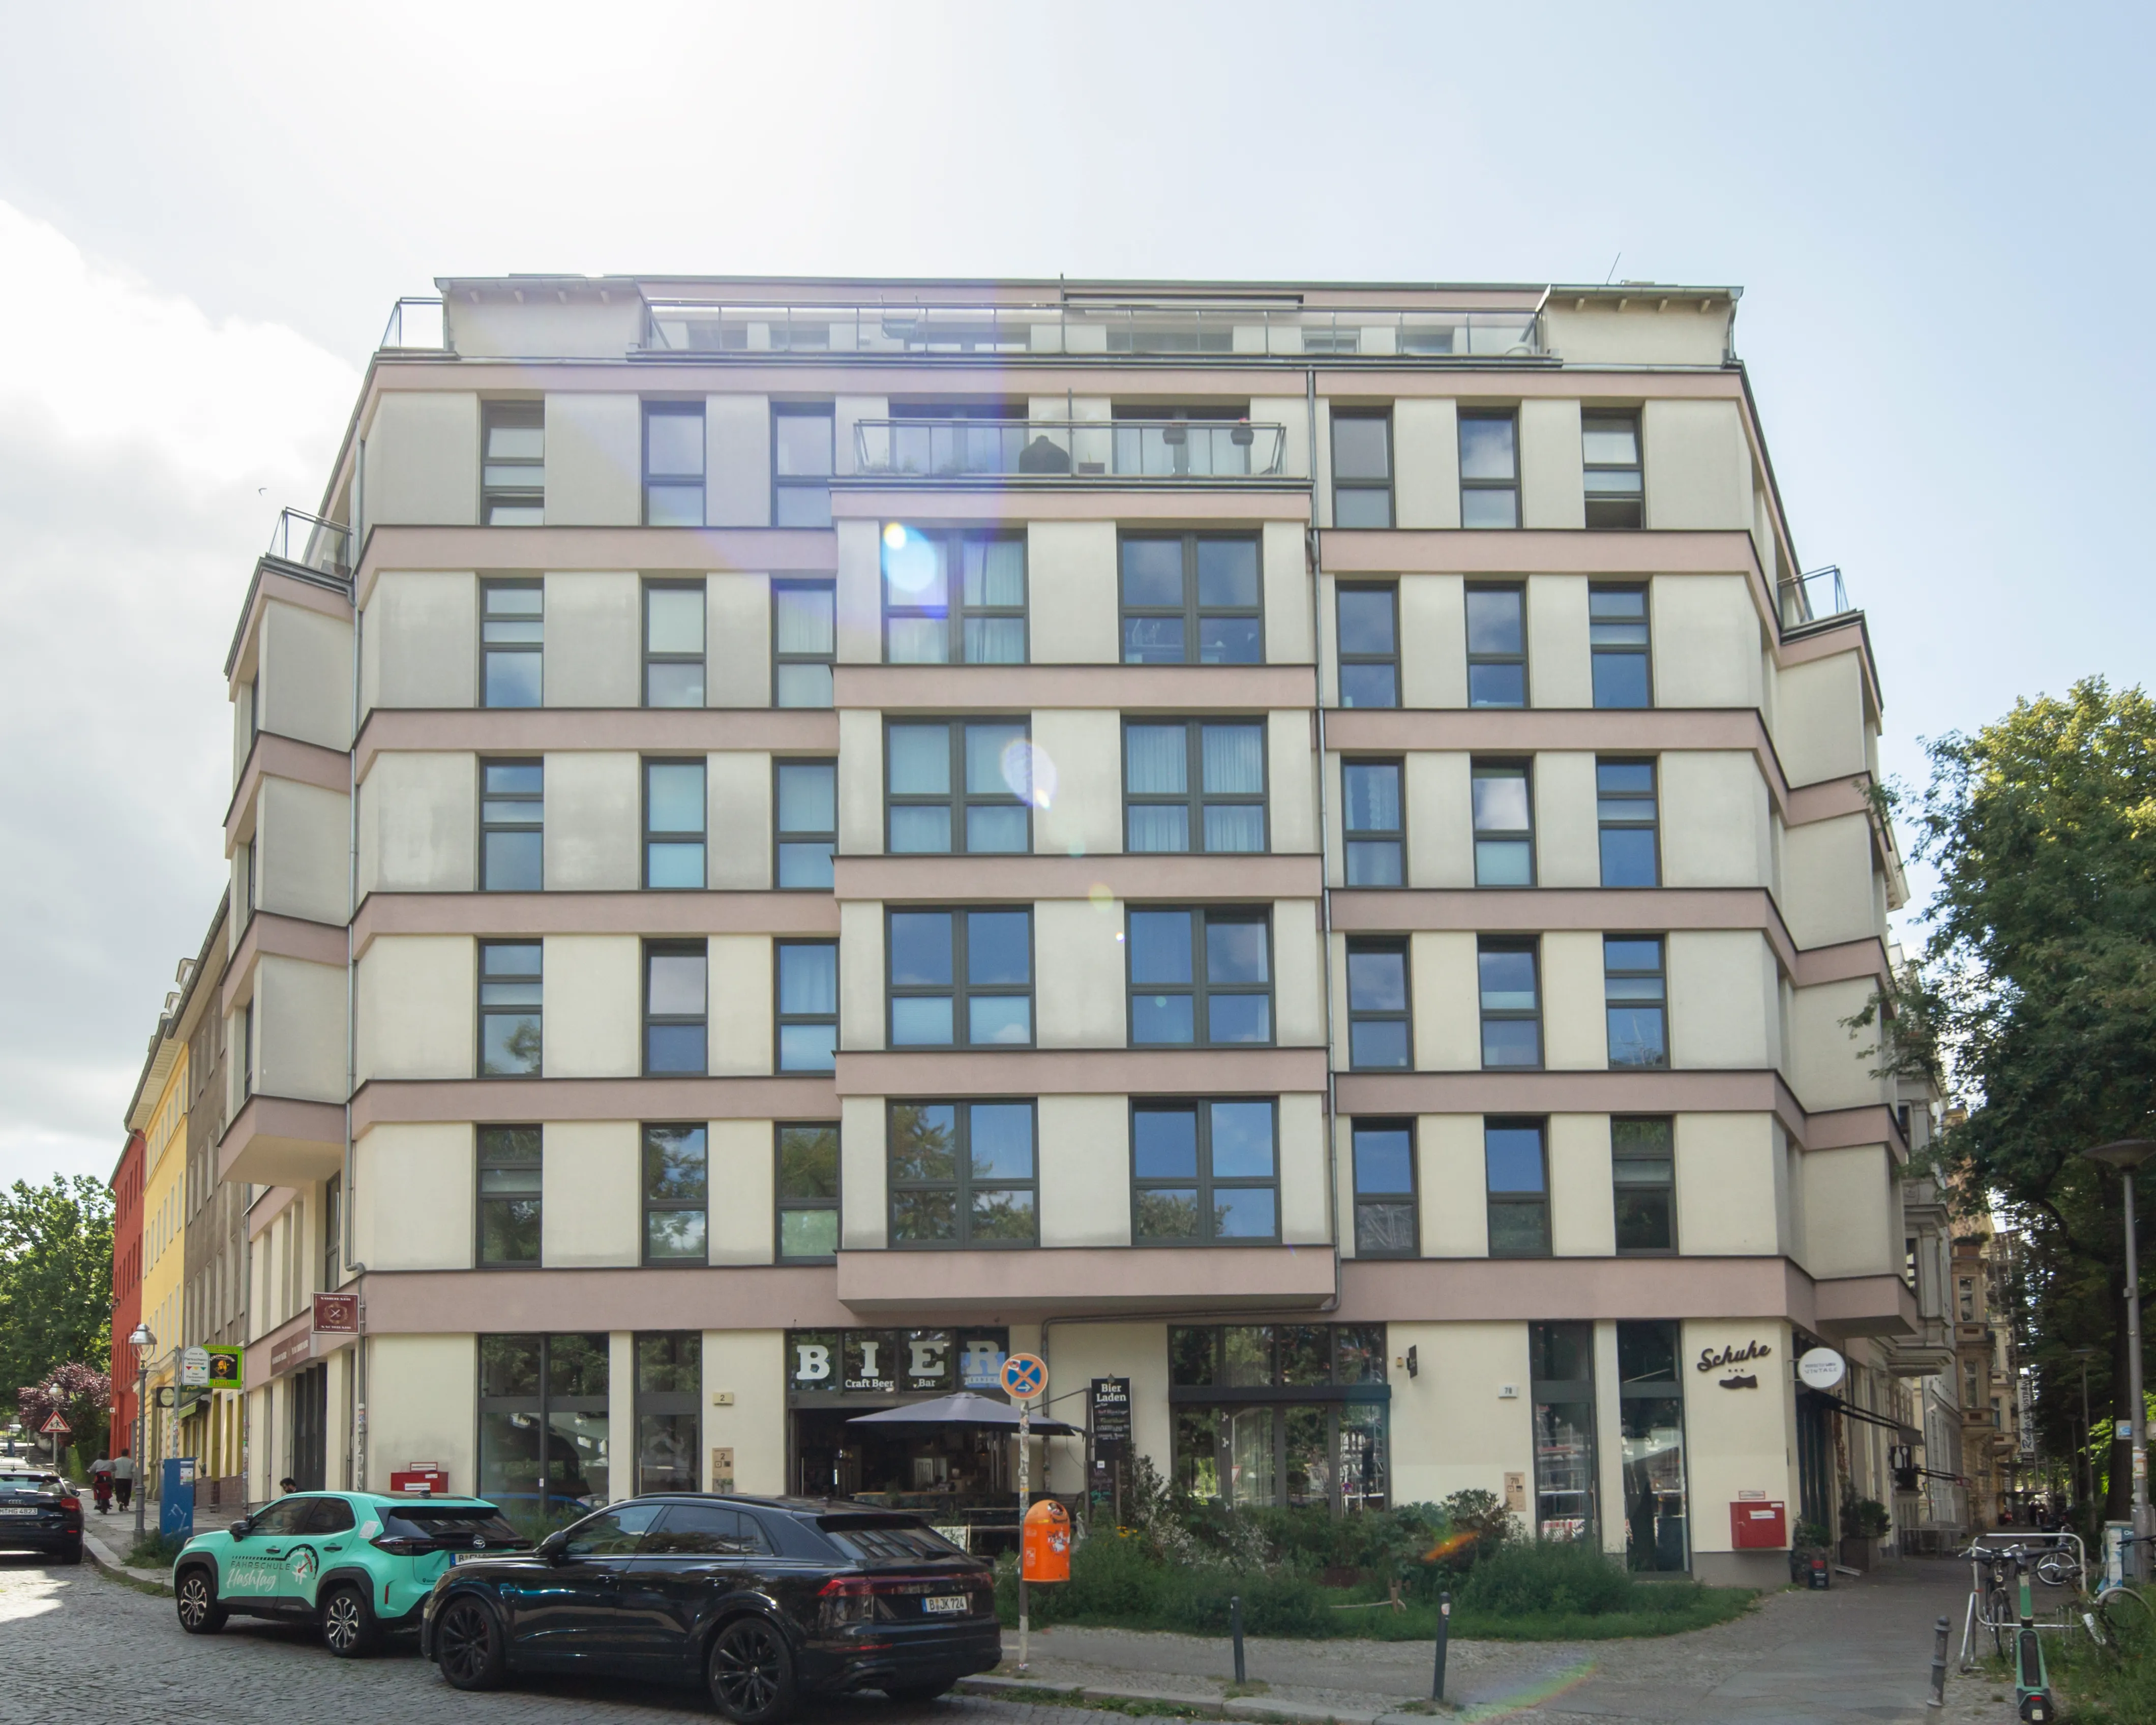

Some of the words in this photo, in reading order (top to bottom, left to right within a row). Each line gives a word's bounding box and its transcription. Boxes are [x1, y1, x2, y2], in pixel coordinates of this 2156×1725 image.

[796, 1340, 1001, 1380] BIER
[1696, 1340, 1772, 1372] Schuhe
[845, 1379, 870, 1388] Craft
[872, 1379, 894, 1387] Beer
[918, 1379, 936, 1387] Bar
[1101, 1383, 1122, 1392] Bier
[1096, 1393, 1127, 1402] Laden
[230, 1561, 291, 1570] FAHRSCHULE
[929, 1599, 935, 1611] B
[940, 1598, 950, 1610] JK
[950, 1598, 964, 1609] 724
